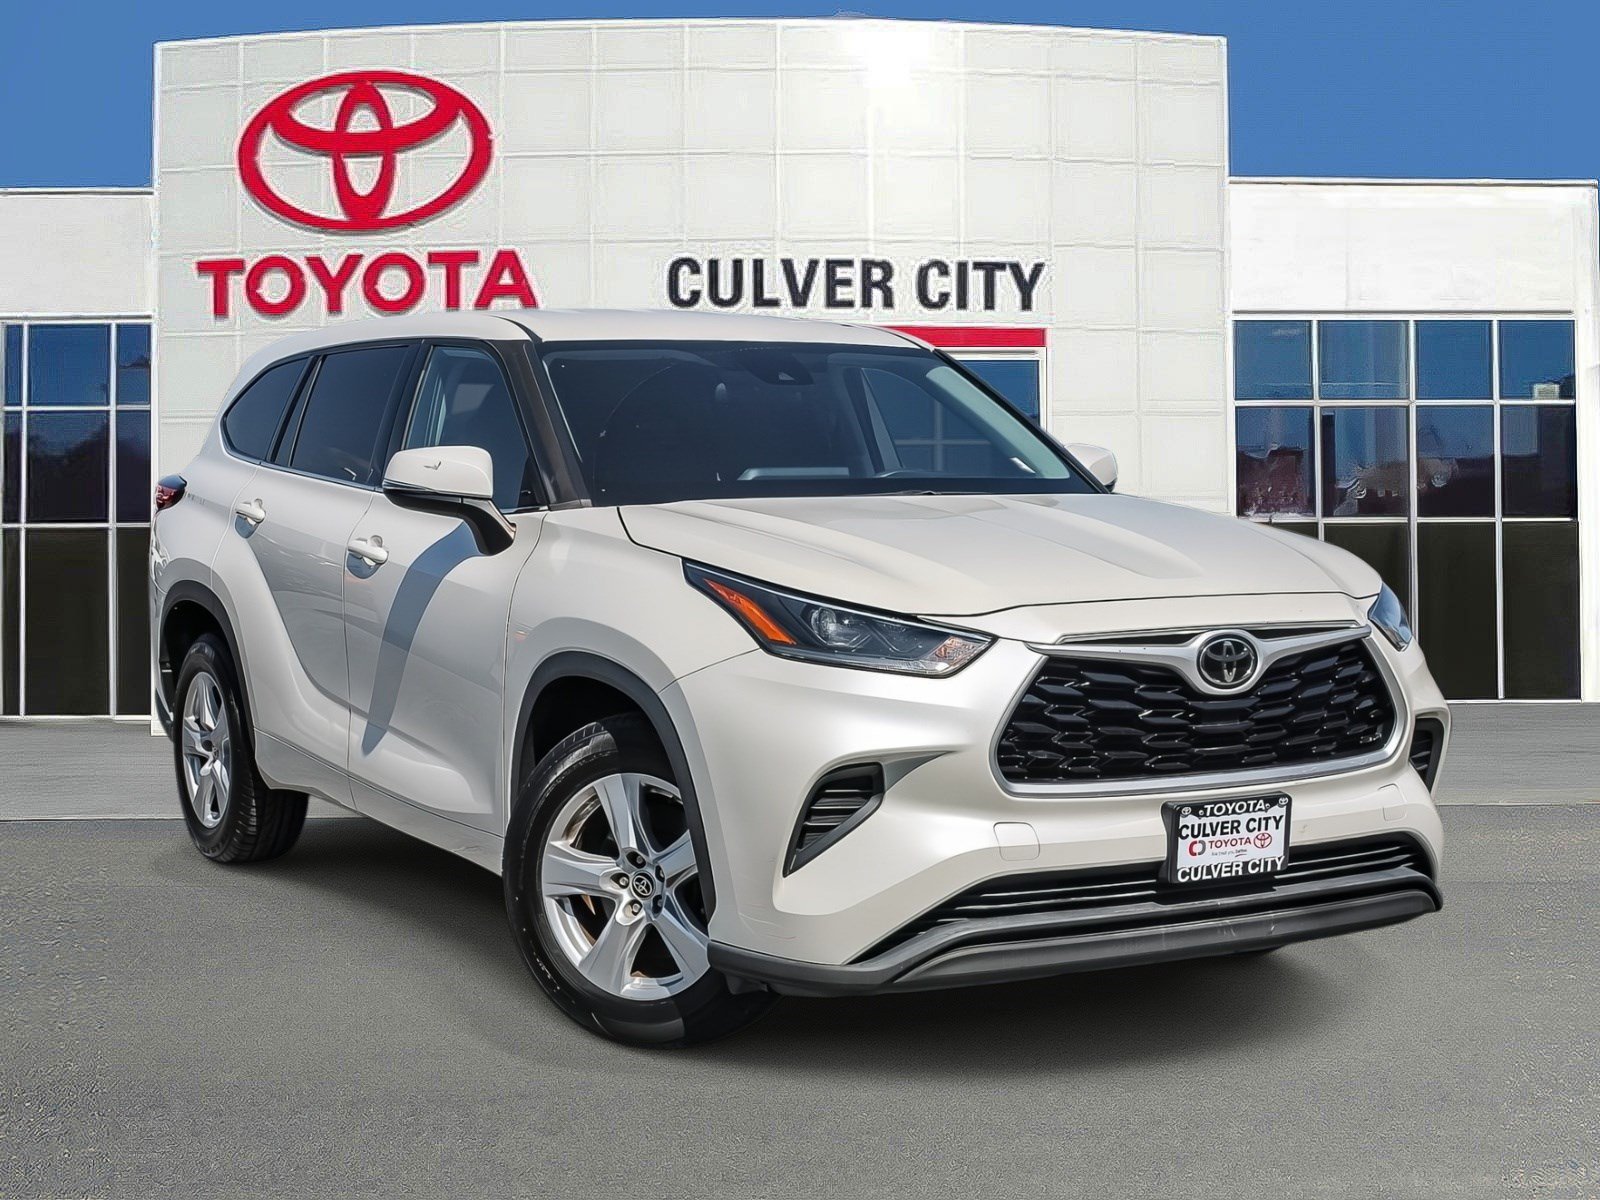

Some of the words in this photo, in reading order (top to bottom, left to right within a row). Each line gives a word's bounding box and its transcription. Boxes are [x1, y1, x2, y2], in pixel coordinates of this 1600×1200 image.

[196, 249, 539, 319] TOYOTA
[668, 257, 895, 309] CULVER
[916, 259, 1045, 311] CITY
[1204, 799, 1265, 816] TOYOTA
[1179, 820, 1240, 840] CULVER
[1246, 815, 1284, 833] CITY
[1208, 837, 1252, 849] TOYOTA
[1177, 861, 1243, 882] CULVER
[1248, 856, 1285, 874] CITY
